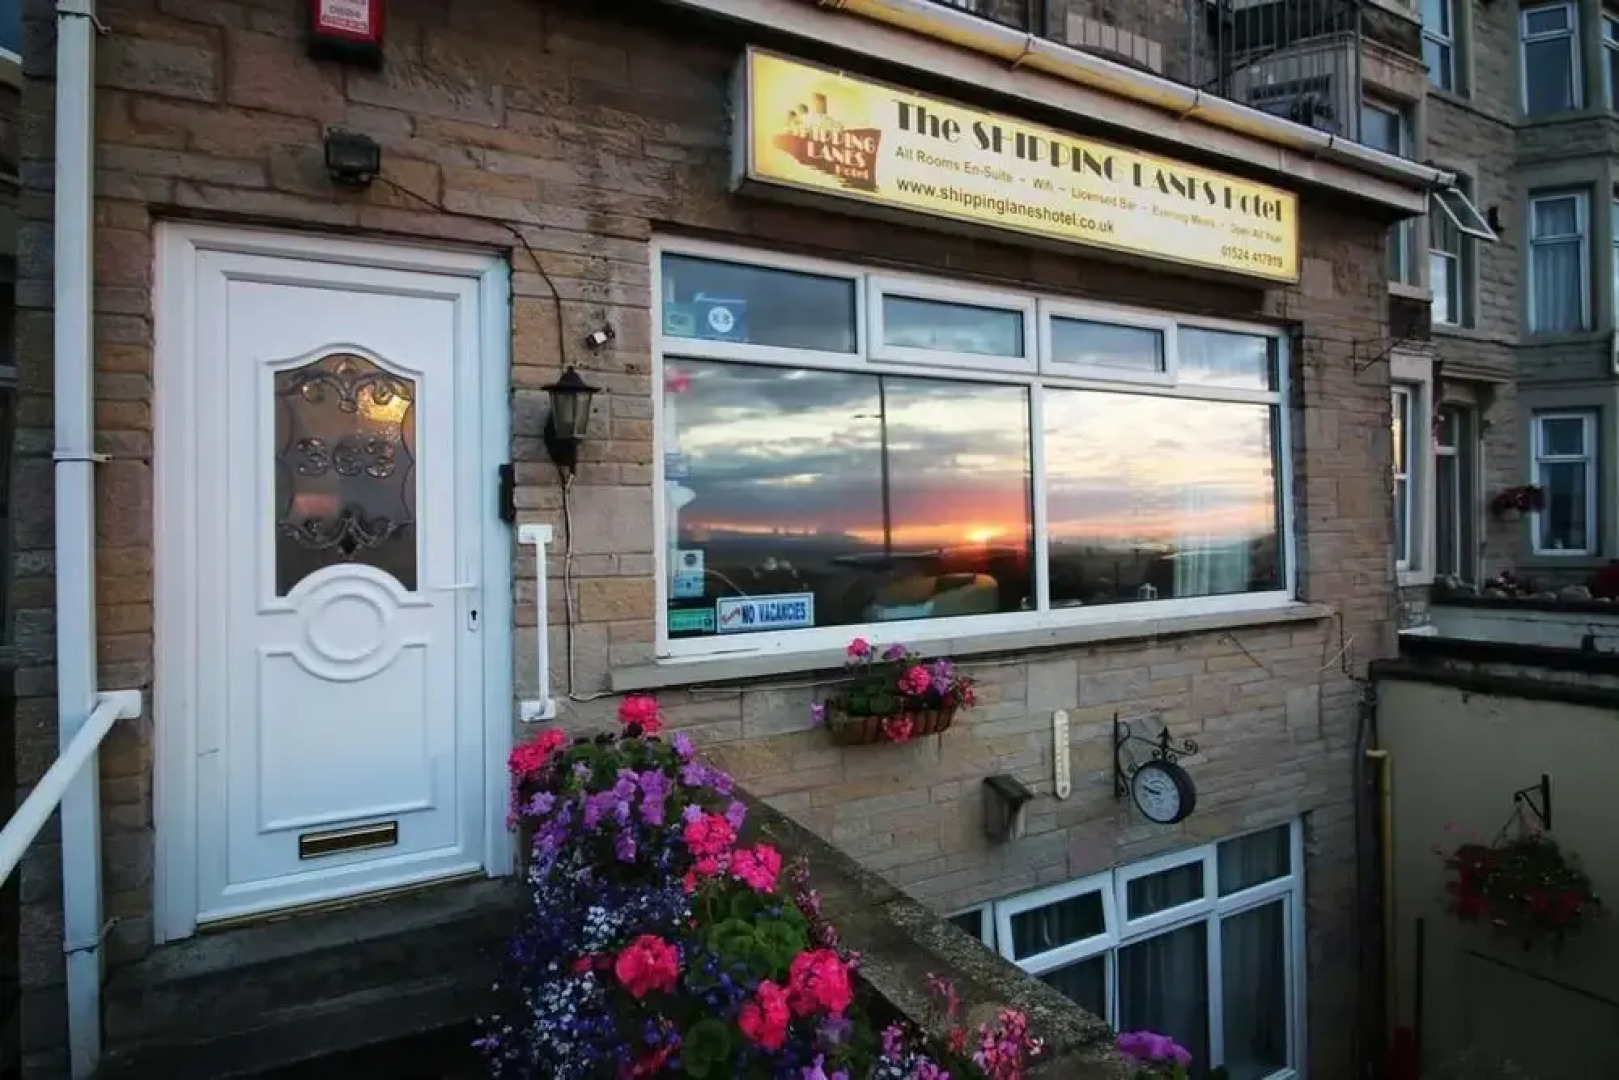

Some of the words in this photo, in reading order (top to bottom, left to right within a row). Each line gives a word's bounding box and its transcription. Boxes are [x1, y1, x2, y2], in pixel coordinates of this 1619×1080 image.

[807, 140, 866, 168] LANES
[893, 100, 961, 143] The
[972, 121, 1122, 182] SHIPPING
[1132, 162, 1217, 205] LANES
[1224, 186, 1282, 222] Hotel
[895, 146, 913, 161] All
[917, 149, 960, 171] Rooms
[964, 161, 1012, 182] En-Suite
[1072, 187, 1117, 207] Licensed
[1119, 196, 1135, 209] Bar
[896, 177, 1114, 233] www.shippinglaneshotel.co.uk
[1222, 245, 1250, 261] 01524
[742, 604, 755, 624] NO
[758, 601, 806, 622] VACANCIES
